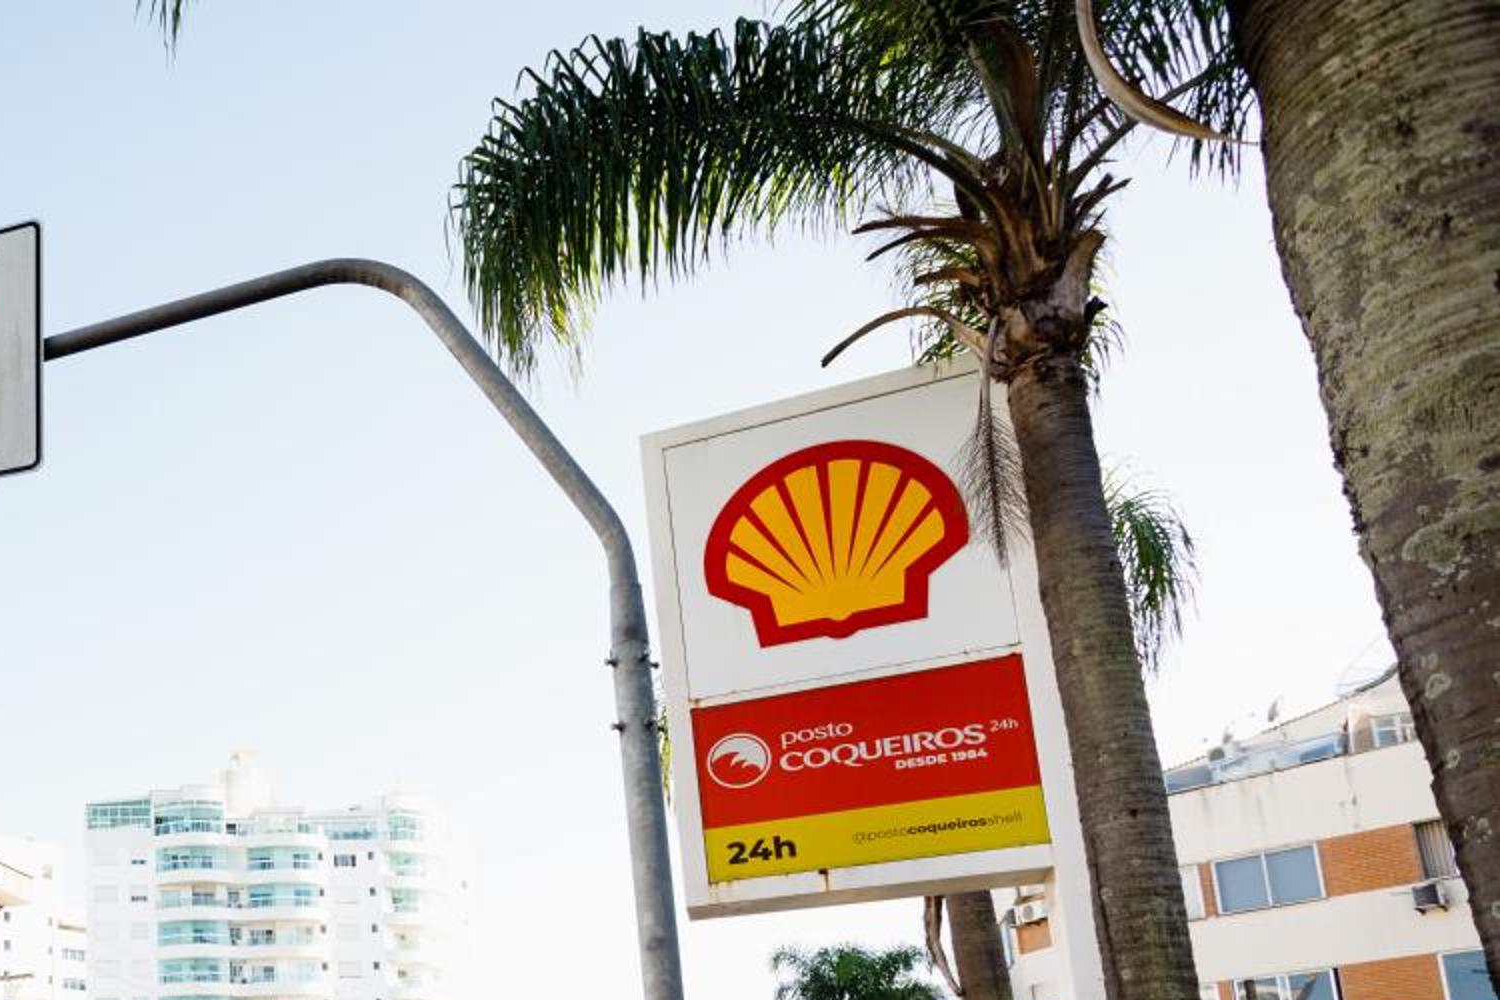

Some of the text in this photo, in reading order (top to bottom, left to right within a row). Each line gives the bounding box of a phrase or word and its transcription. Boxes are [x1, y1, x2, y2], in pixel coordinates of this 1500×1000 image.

[779, 717, 1019, 772] COQUEIROS 24h
[781, 720, 853, 750] posto
[895, 746, 988, 771] DESDE 1984
[726, 835, 797, 866] 24h
